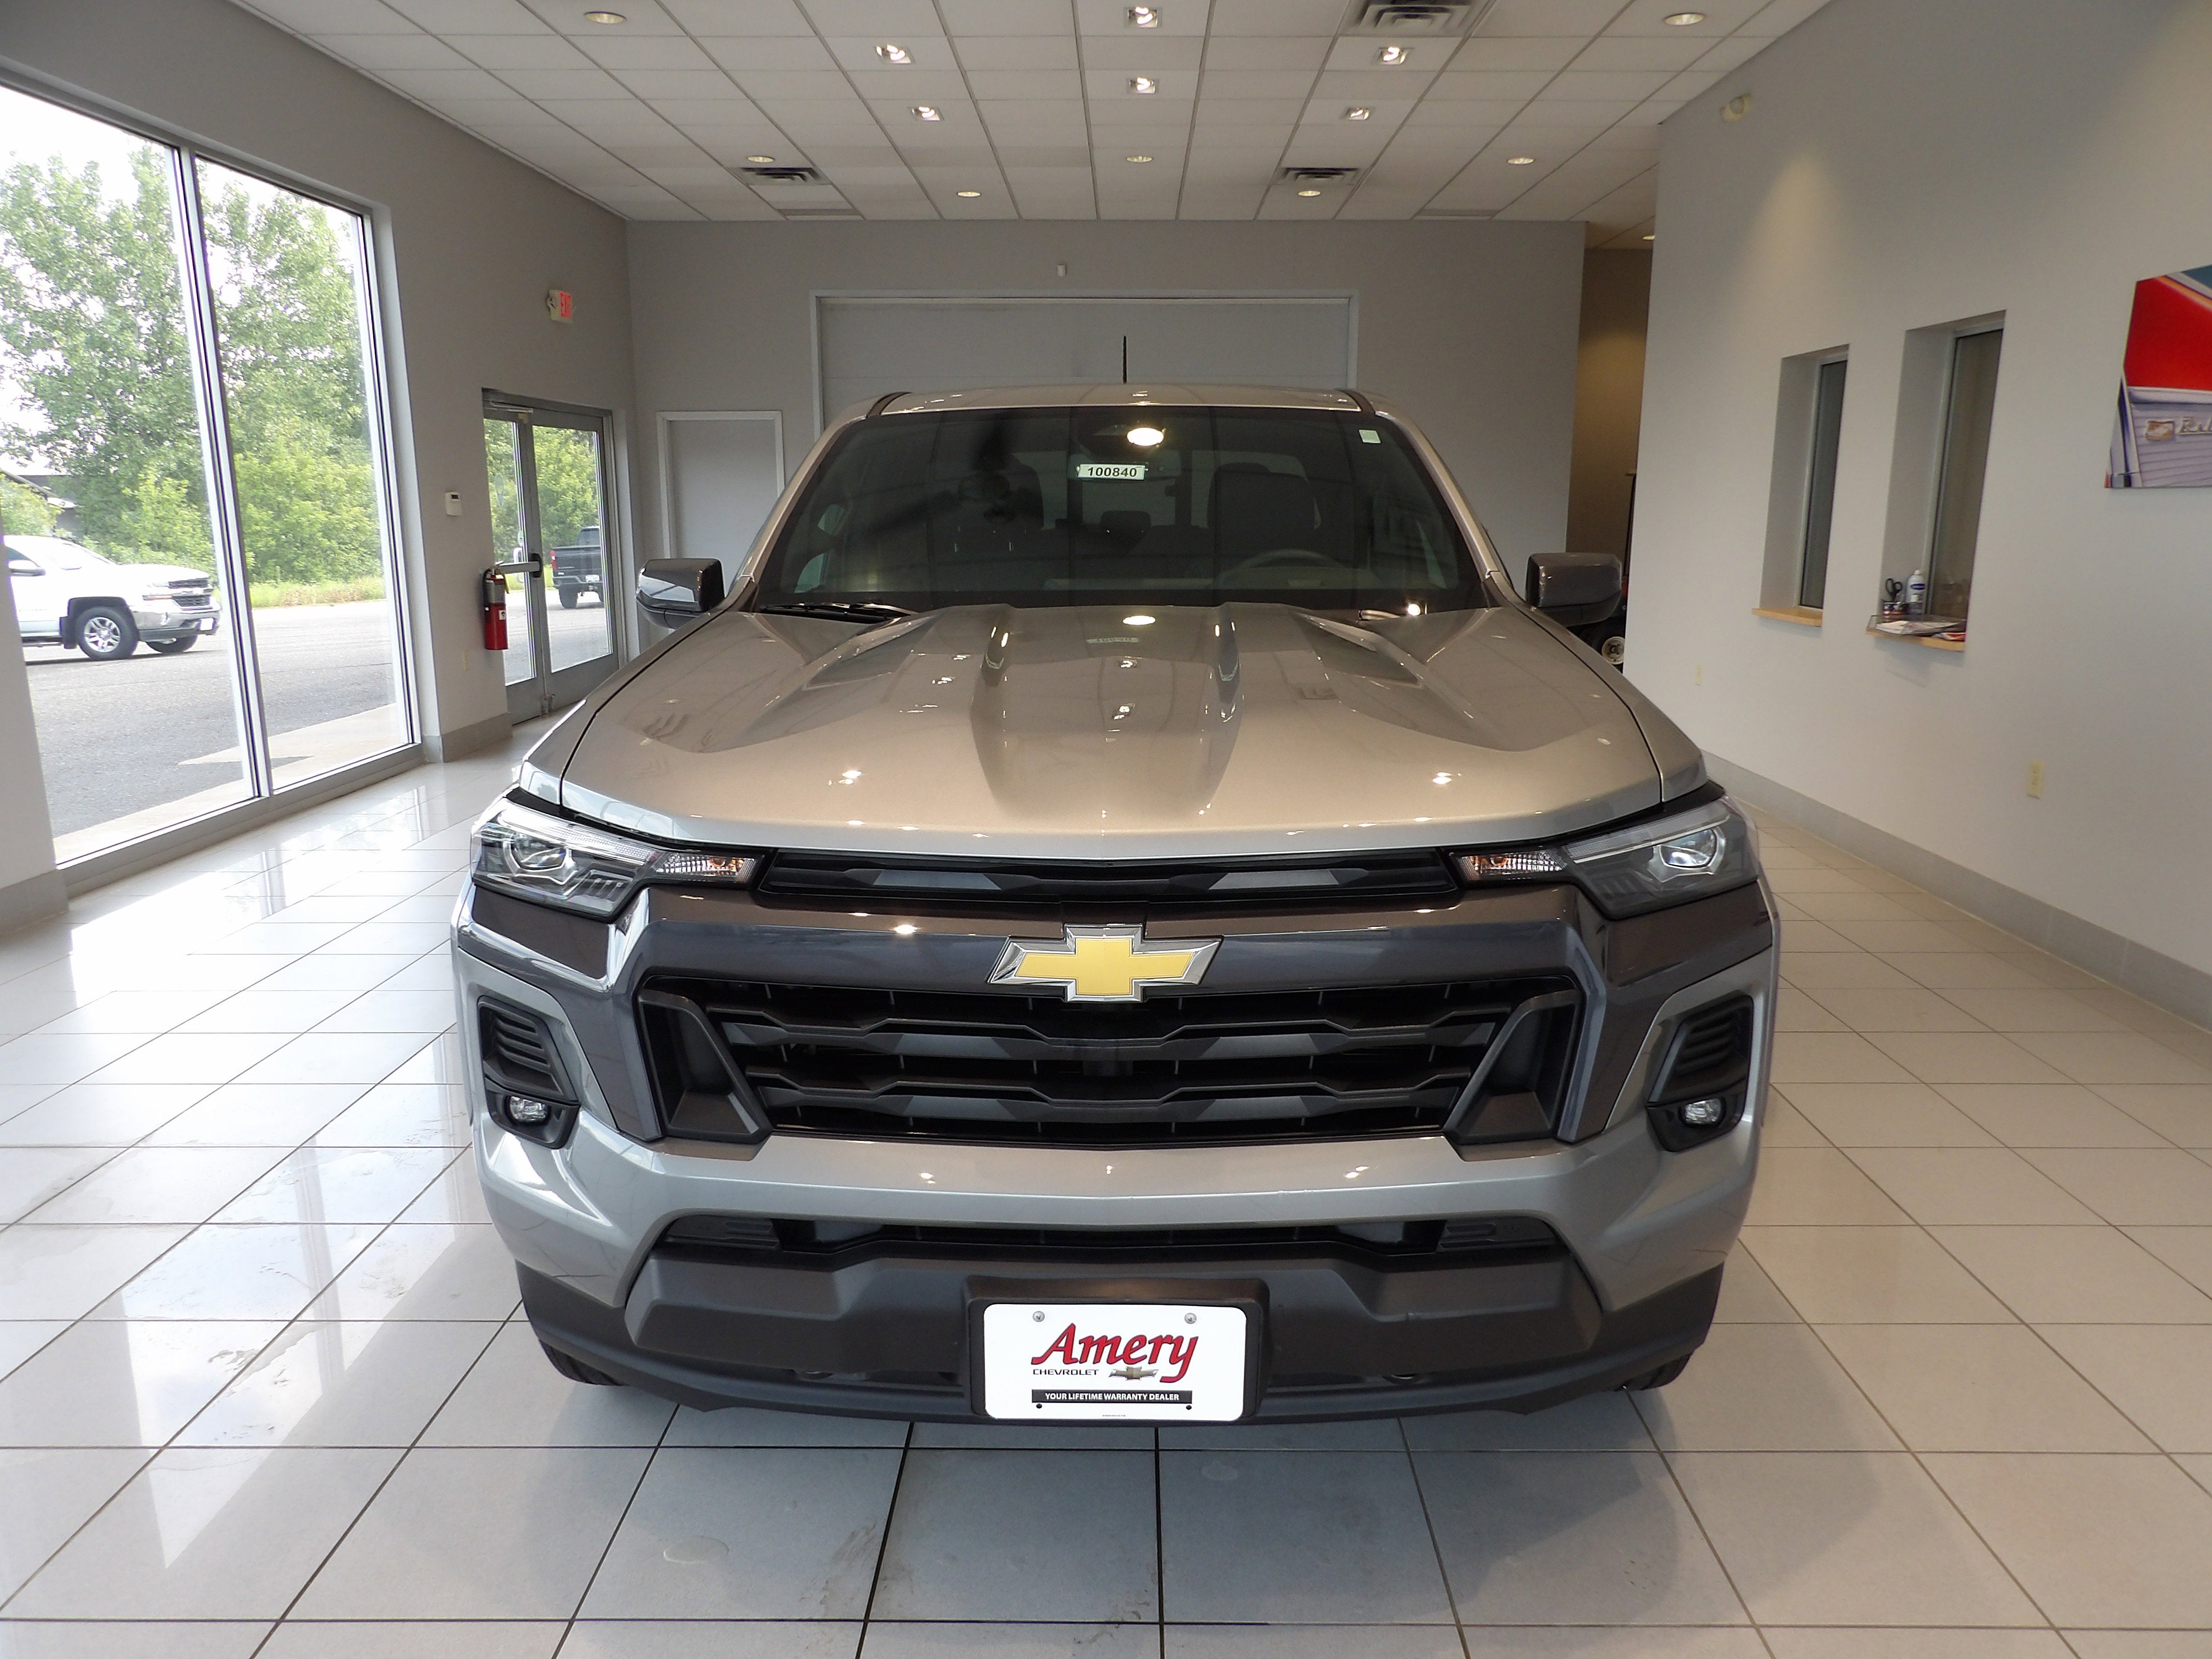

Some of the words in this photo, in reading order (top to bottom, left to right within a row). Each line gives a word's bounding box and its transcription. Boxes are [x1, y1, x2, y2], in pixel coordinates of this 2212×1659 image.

[1087, 467, 1137, 477] 100840
[1031, 1322, 1199, 1383] Amery
[1068, 1393, 1103, 1401] LIFETIME
[1104, 1393, 1148, 1401] WARRANTY
